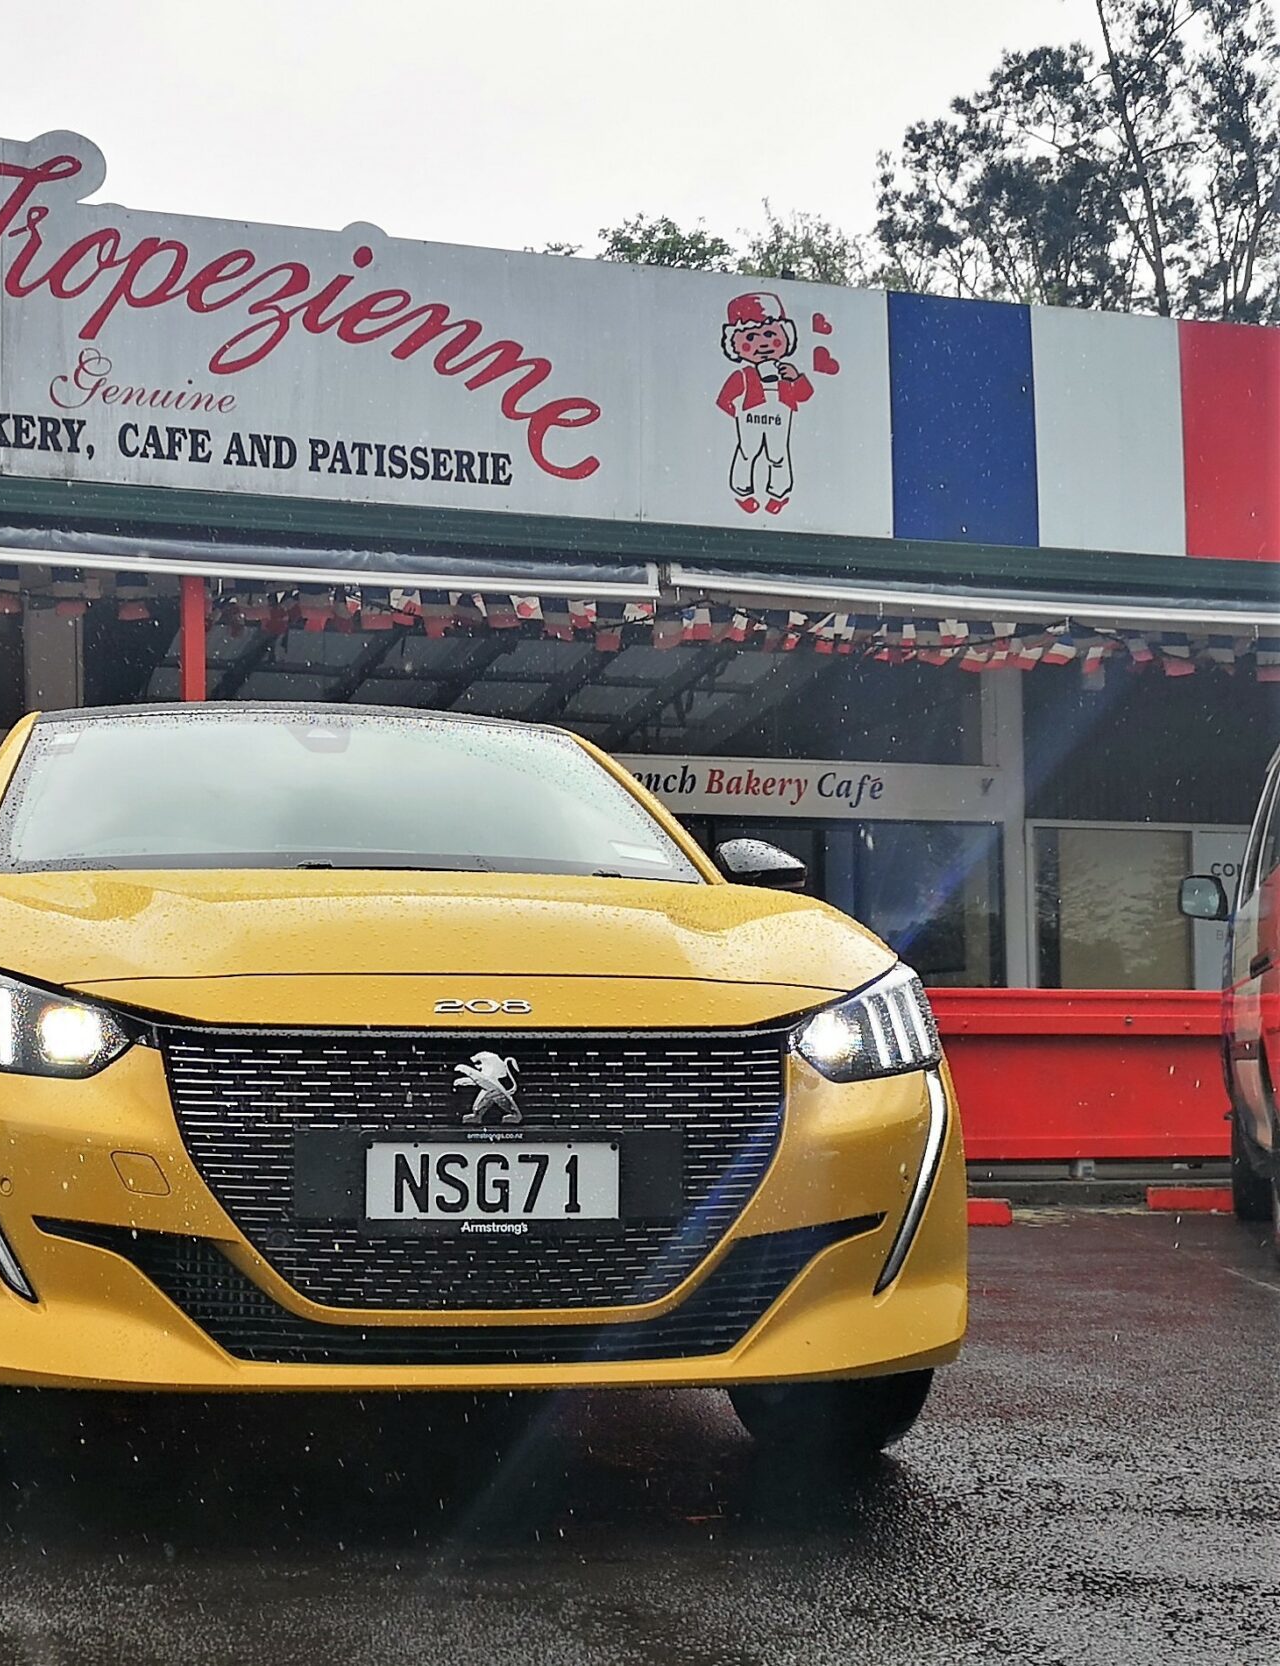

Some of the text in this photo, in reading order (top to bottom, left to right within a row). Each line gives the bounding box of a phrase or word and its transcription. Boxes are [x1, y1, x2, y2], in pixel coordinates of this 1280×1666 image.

[49, 347, 238, 414] Genuine
[745, 412, 782, 426] André
[117, 422, 212, 465] CAFE
[223, 432, 298, 471] AND
[308, 437, 514, 488] PATISSERIE
[704, 769, 808, 806] Bakery
[817, 772, 884, 809] Café
[434, 999, 532, 1014] 208
[393, 1153, 581, 1214] NSG71
[460, 1221, 529, 1236] Armstrong's
